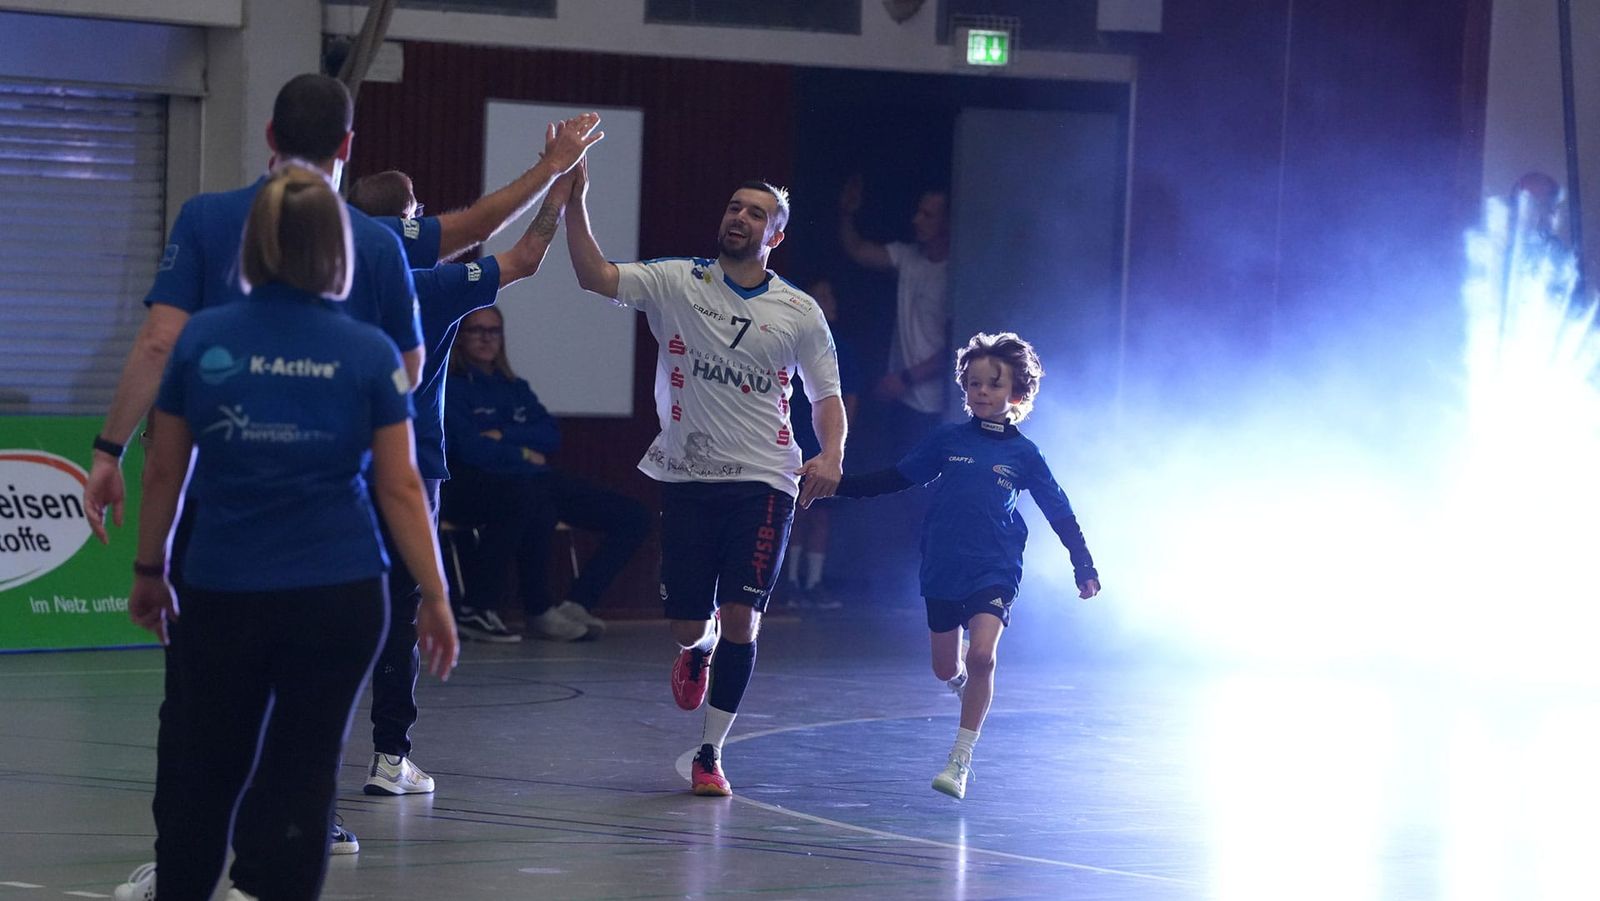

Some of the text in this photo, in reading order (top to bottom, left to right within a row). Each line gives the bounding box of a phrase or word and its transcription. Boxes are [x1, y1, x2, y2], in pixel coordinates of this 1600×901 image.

[693, 303, 719, 320] CRAFT
[730, 315, 752, 349] 7
[692, 358, 772, 394] HANAU
[948, 455, 969, 463] CRAFT
[0, 484, 84, 519] eisen
[752, 526, 775, 569] HSB
[743, 585, 763, 596] CRAFT
[29, 595, 129, 613] Im Netz unter
